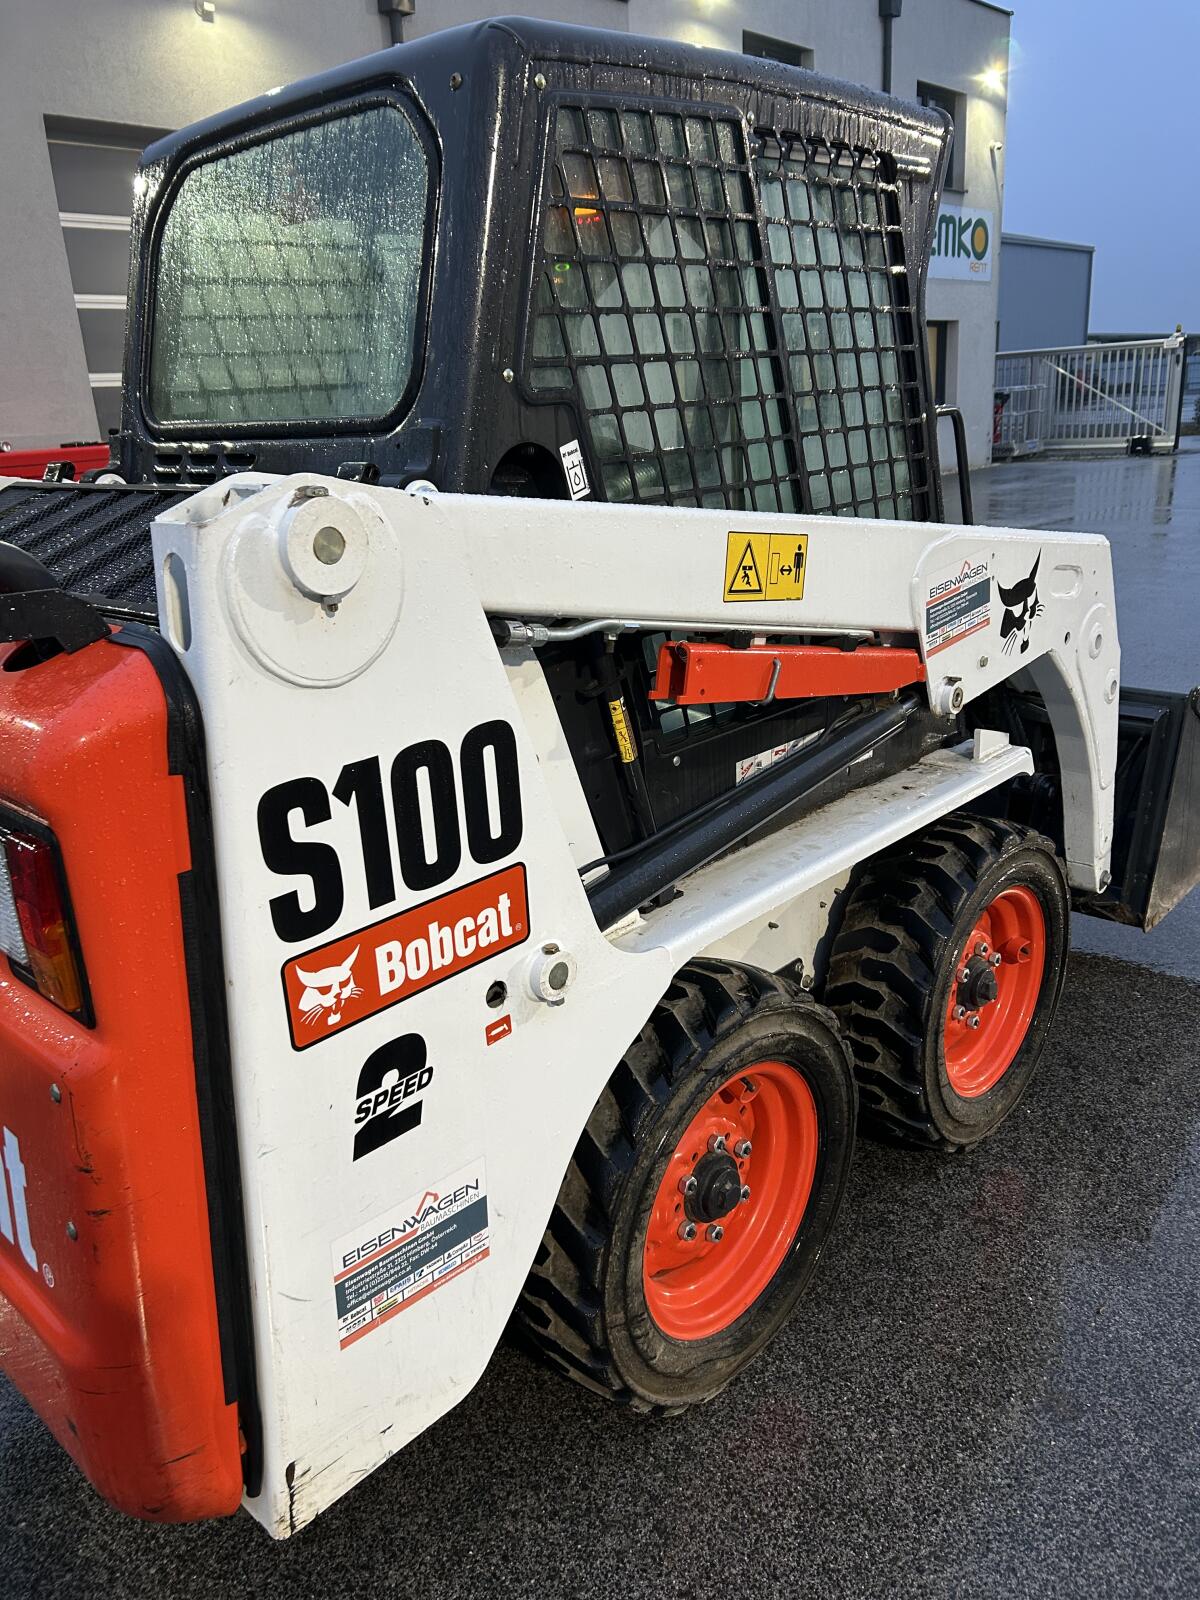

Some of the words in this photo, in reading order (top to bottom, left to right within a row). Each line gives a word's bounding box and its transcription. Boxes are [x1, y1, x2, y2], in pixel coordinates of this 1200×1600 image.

[929, 561, 988, 598] EISENWAGEN
[257, 719, 523, 943] S100
[374, 892, 513, 997] Bobcat
[352, 1032, 427, 1162] 2
[354, 1065, 434, 1125] SPEED
[342, 1178, 479, 1269] EISENWAGEN
[420, 1191, 480, 1231] BAUMASCHINEN
[345, 1264, 379, 1288] Eisenwagen
[379, 1241, 418, 1267] Baumaschinen
[418, 1230, 435, 1243] GmbH
[345, 1266, 387, 1295] Industriestraße
[431, 1223, 458, 1242] Österreich
[346, 1292, 358, 1301] Tel.:
[409, 1252, 420, 1262] Fax:
